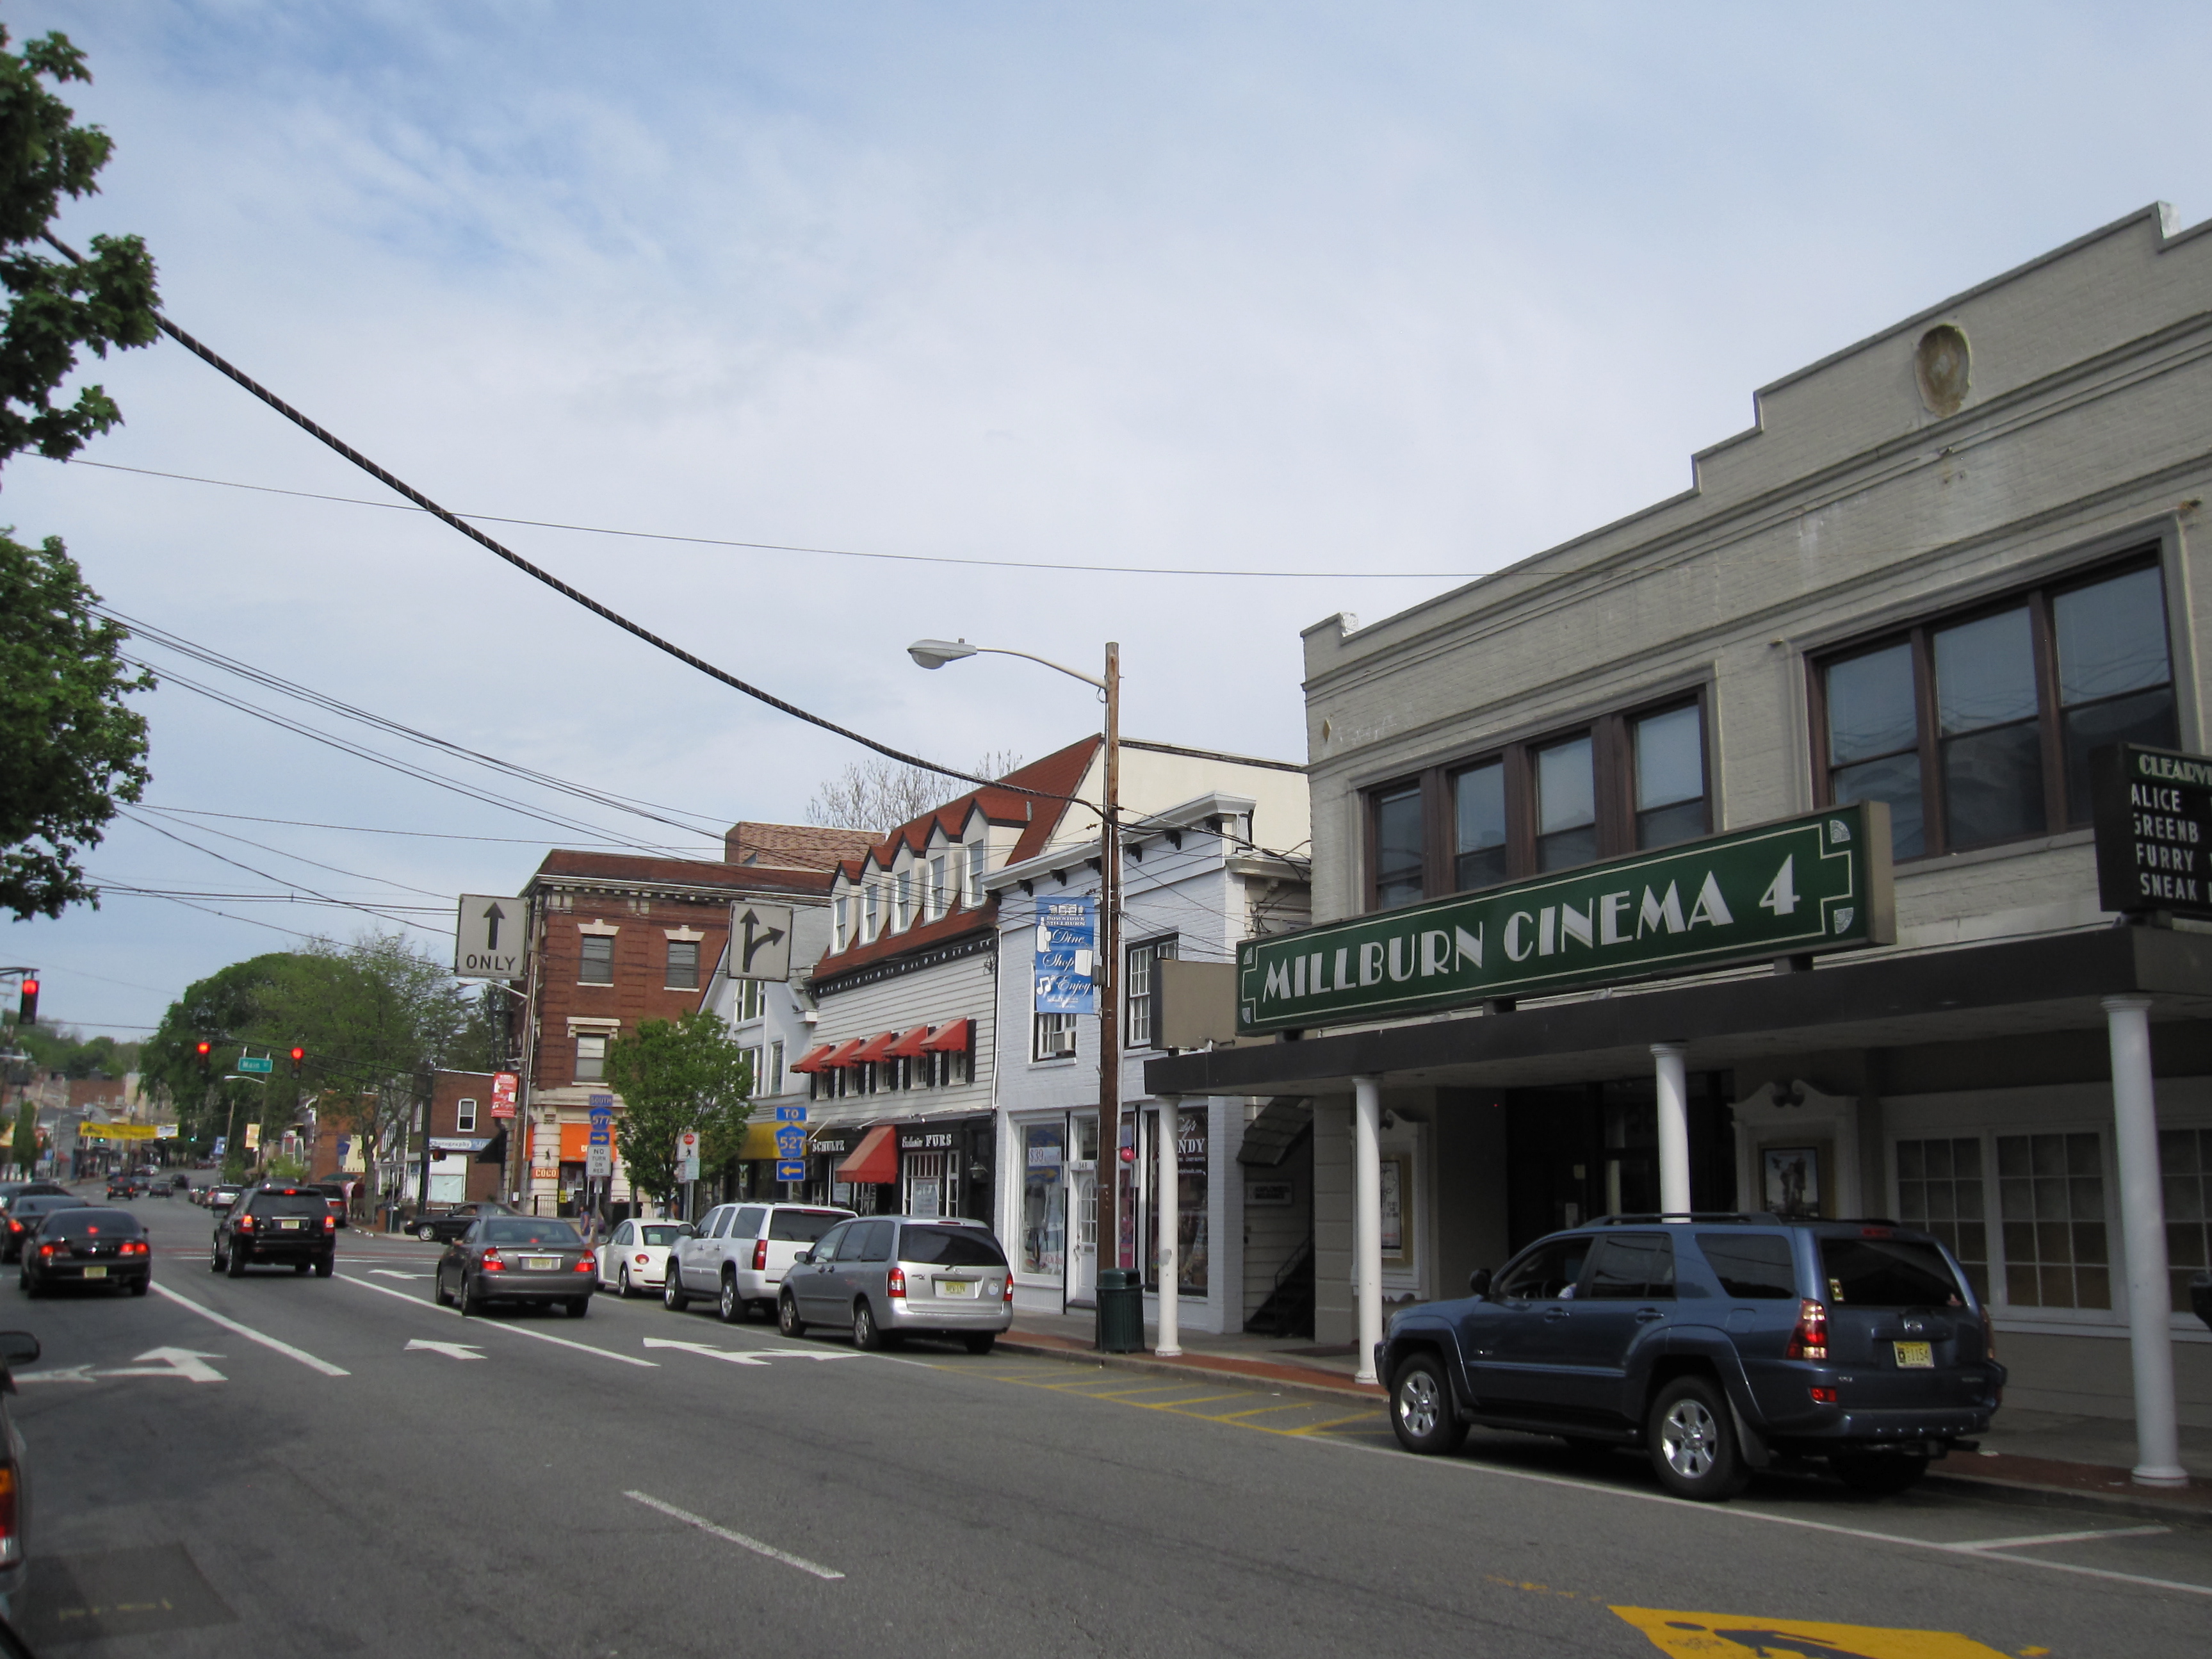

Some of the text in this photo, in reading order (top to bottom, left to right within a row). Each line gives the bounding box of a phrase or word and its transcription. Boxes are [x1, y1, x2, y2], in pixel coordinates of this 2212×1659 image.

[2131, 783, 2181, 812] ALICE
[2136, 843, 2193, 871] FURRY
[2140, 872, 2197, 901] SNEAK
[1052, 928, 1086, 944] Dine
[1263, 854, 1801, 1003] MILLBURN CINEMA 4
[466, 954, 516, 971] ONLY
[1042, 952, 1074, 972] Shop
[1057, 975, 1092, 997] Enjoy
[243, 1061, 260, 1069] Main
[592, 1115, 610, 1125] 577
[784, 1109, 799, 1119] TO
[780, 1136, 805, 1149] 527
[813, 1140, 845, 1152] SCHULTZ
[925, 1133, 952, 1147] FURS
[1030, 1148, 1043, 1163] $39
